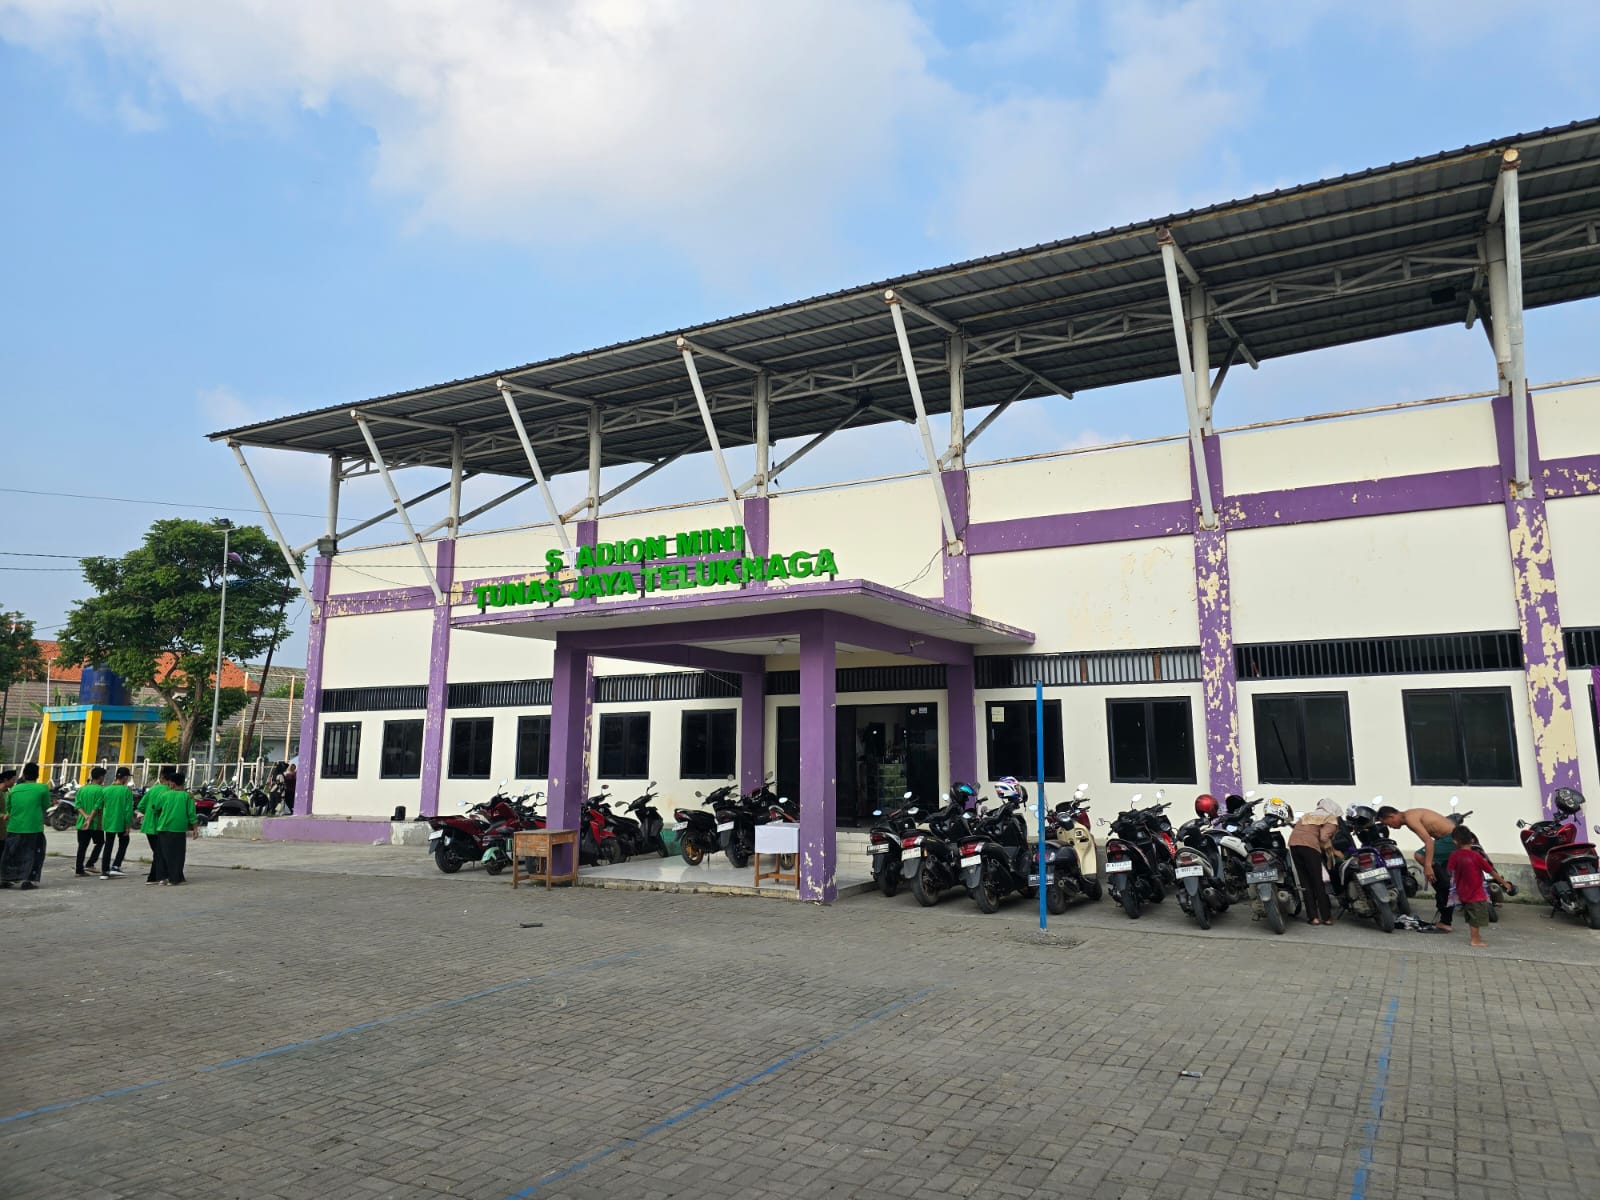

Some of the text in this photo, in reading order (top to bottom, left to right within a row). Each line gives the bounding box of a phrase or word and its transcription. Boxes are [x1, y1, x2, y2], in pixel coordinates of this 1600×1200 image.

[676, 526, 746, 553] MINI
[473, 549, 838, 609] TUNAS JAYA TELUKNAGA
